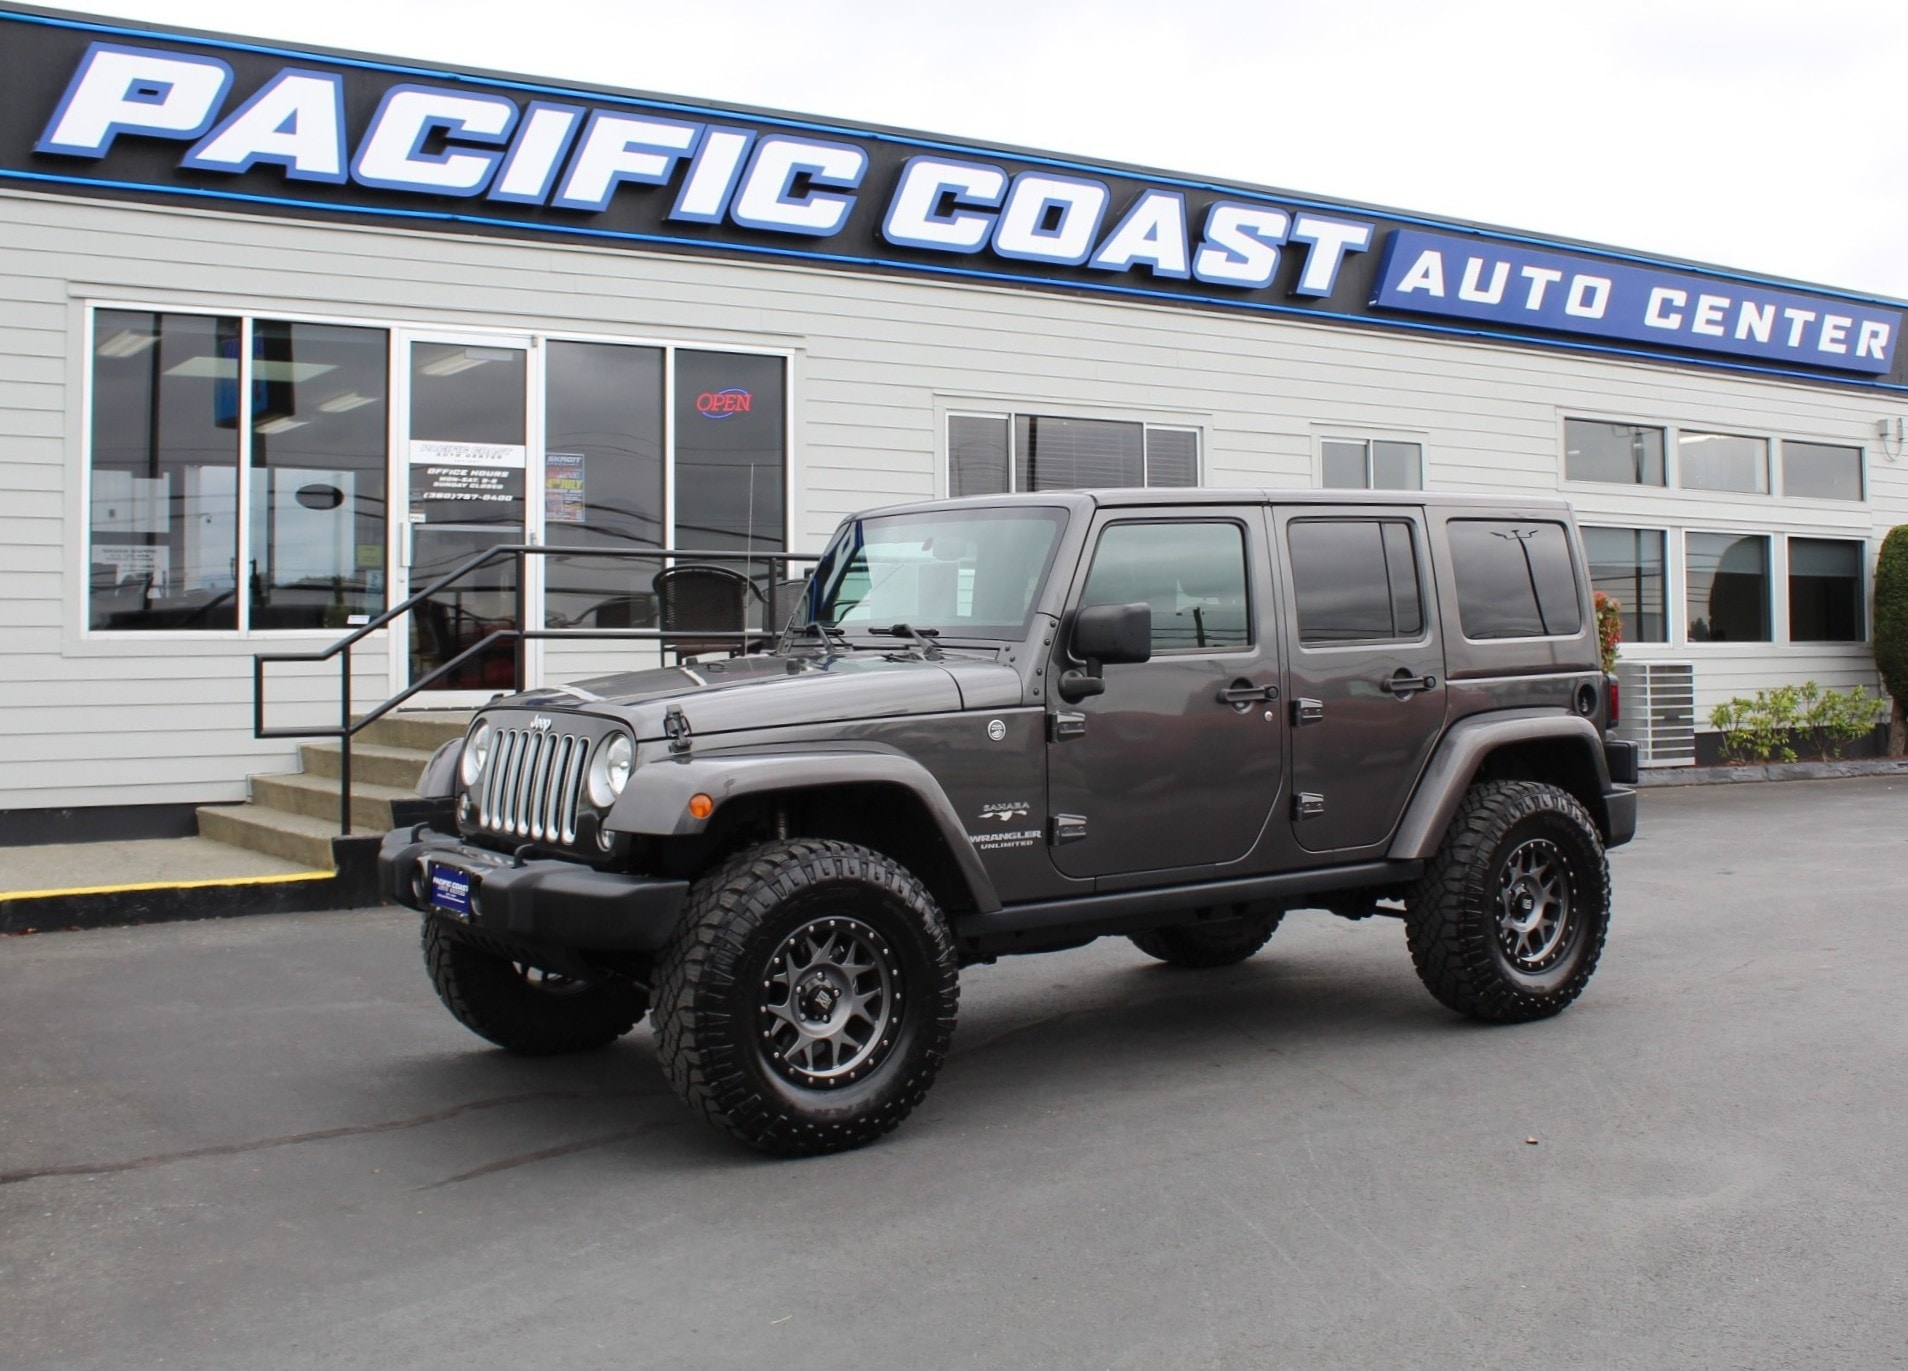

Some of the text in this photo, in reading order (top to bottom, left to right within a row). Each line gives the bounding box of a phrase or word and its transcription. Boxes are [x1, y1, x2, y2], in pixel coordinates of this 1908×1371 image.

[33, 41, 1374, 299] PACIFIC COAST
[1396, 249, 1891, 362] AUTO CENTER
[696, 392, 752, 412] OPEN
[426, 467, 510, 478] OFFICE HOURS
[530, 714, 552, 732] Jeep
[982, 802, 1030, 812] SAHARA
[969, 830, 1041, 843] WRANGLER
[980, 840, 1033, 850] UNLIMITED
